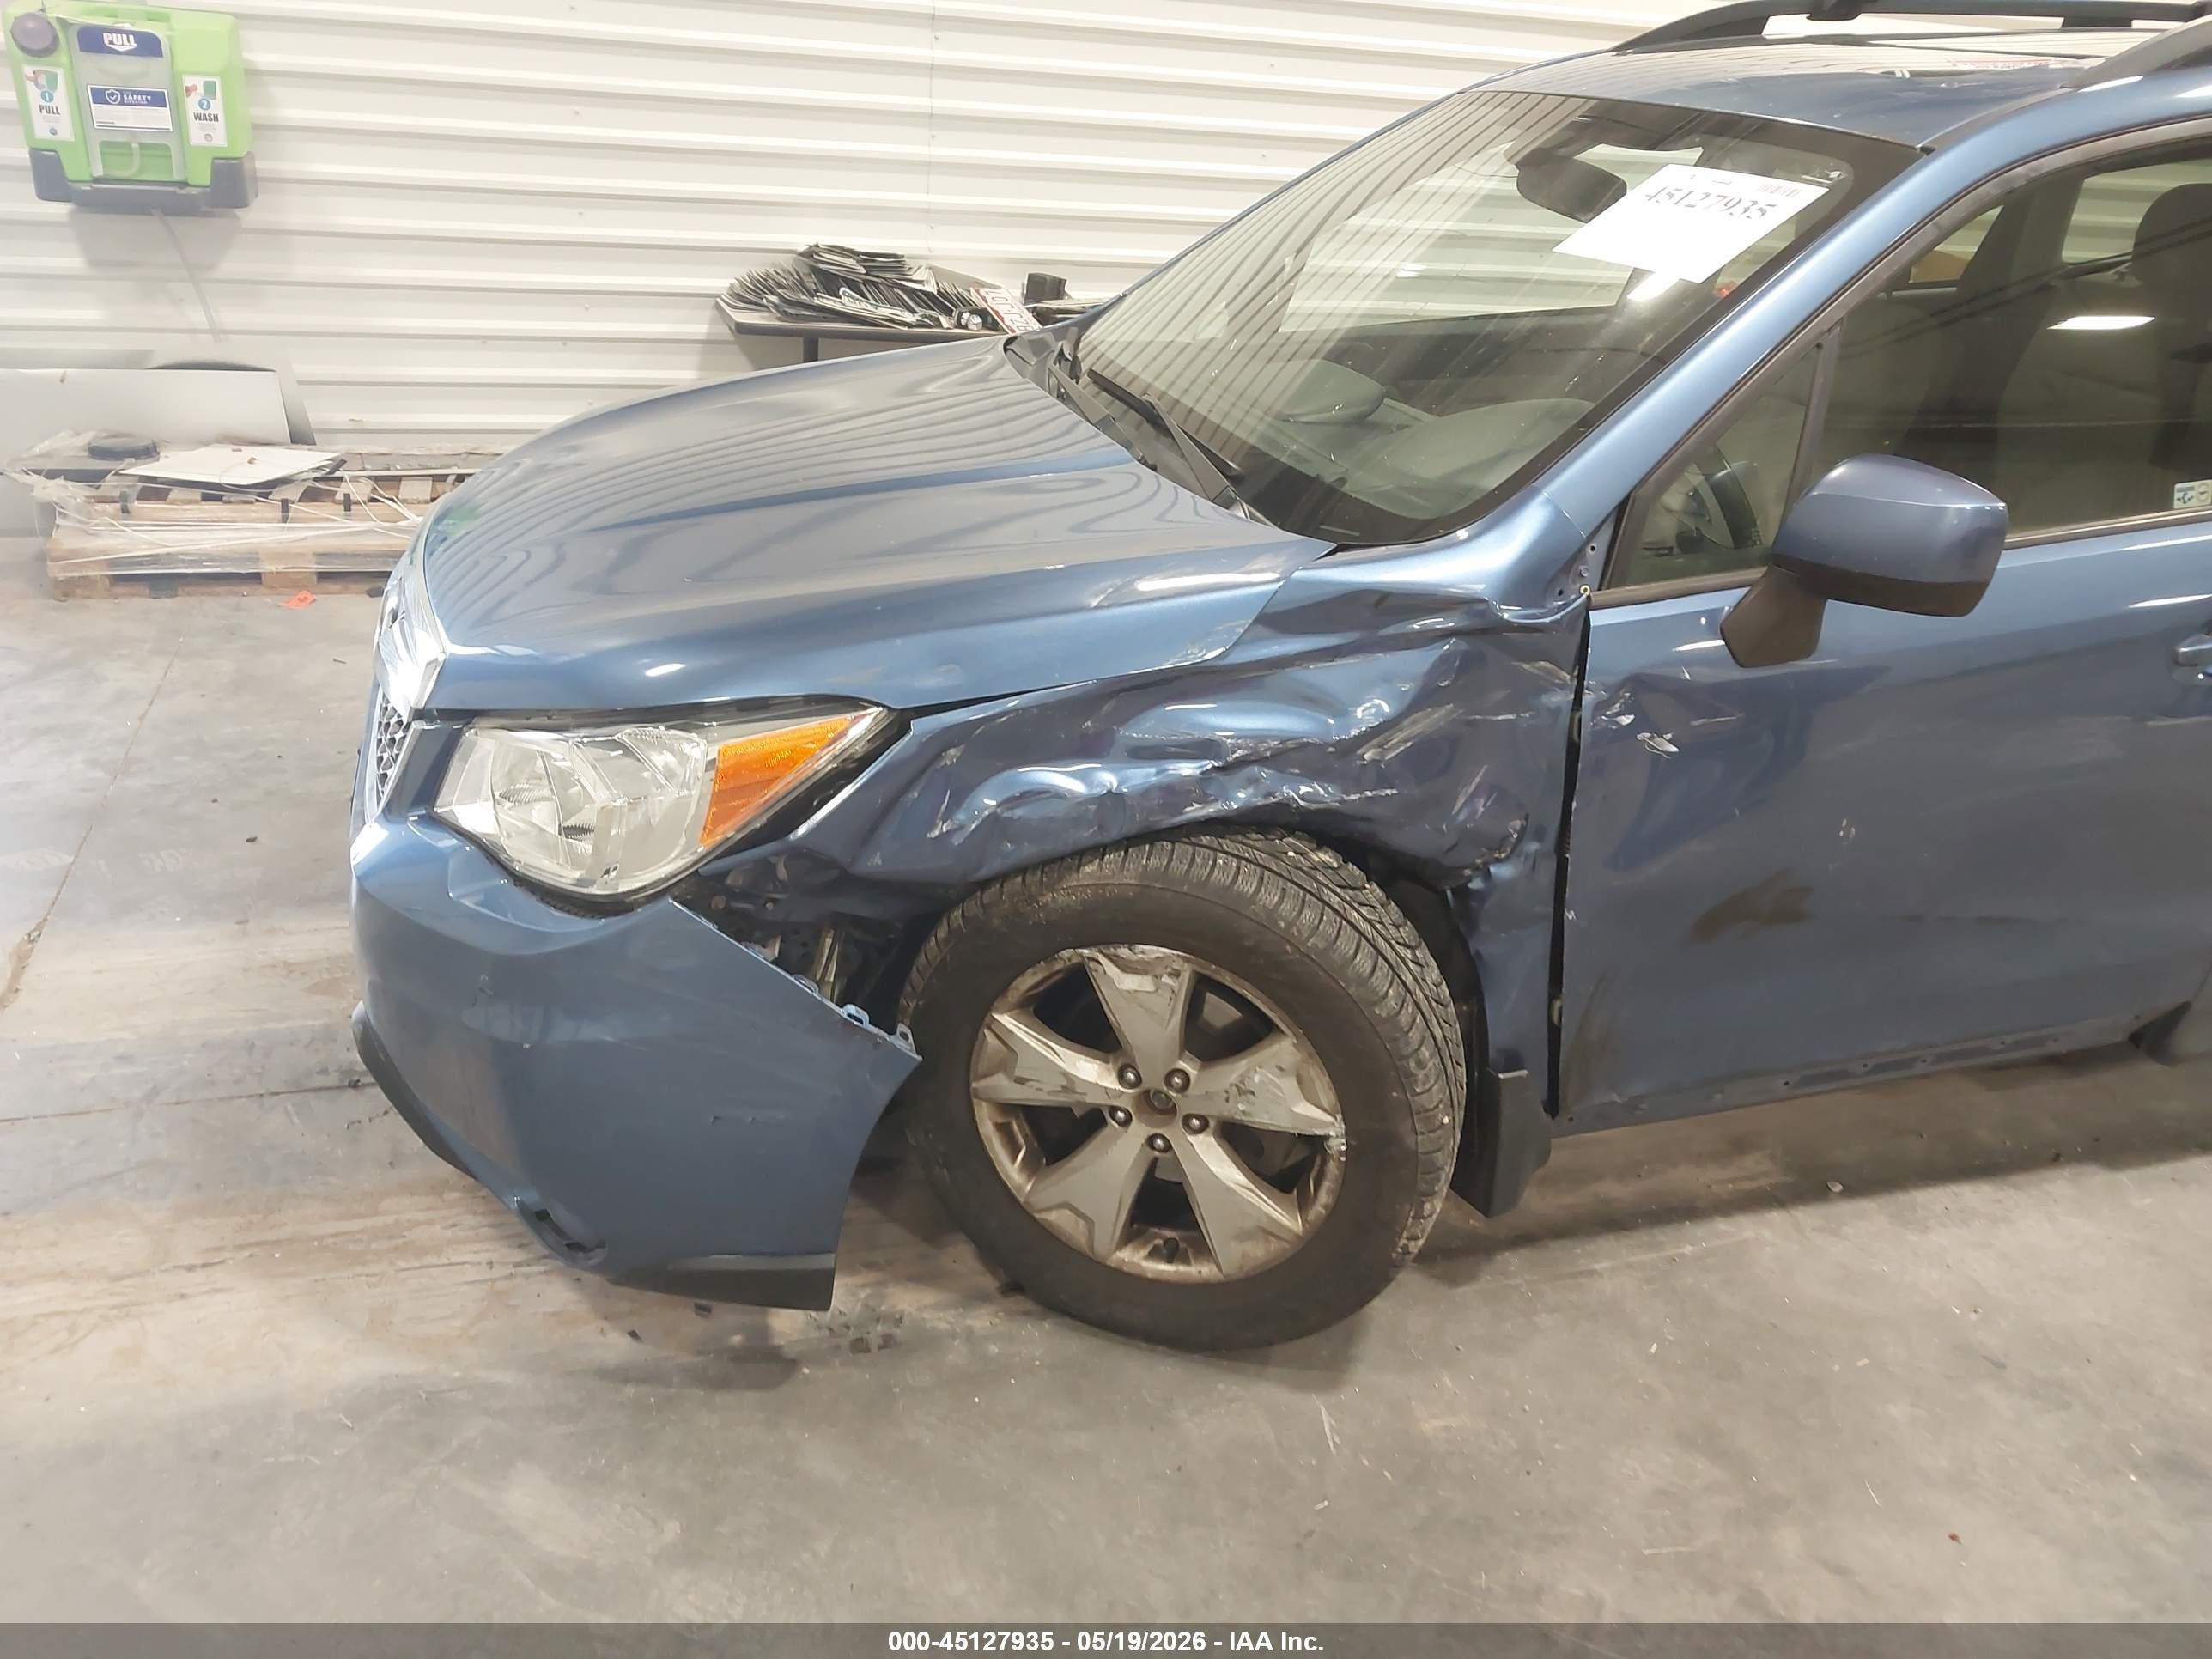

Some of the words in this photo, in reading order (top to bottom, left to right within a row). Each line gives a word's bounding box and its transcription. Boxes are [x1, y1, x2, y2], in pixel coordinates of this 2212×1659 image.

[102, 32, 137, 46] PULL
[39, 104, 61, 116] PULL
[193, 112, 220, 123] WASH
